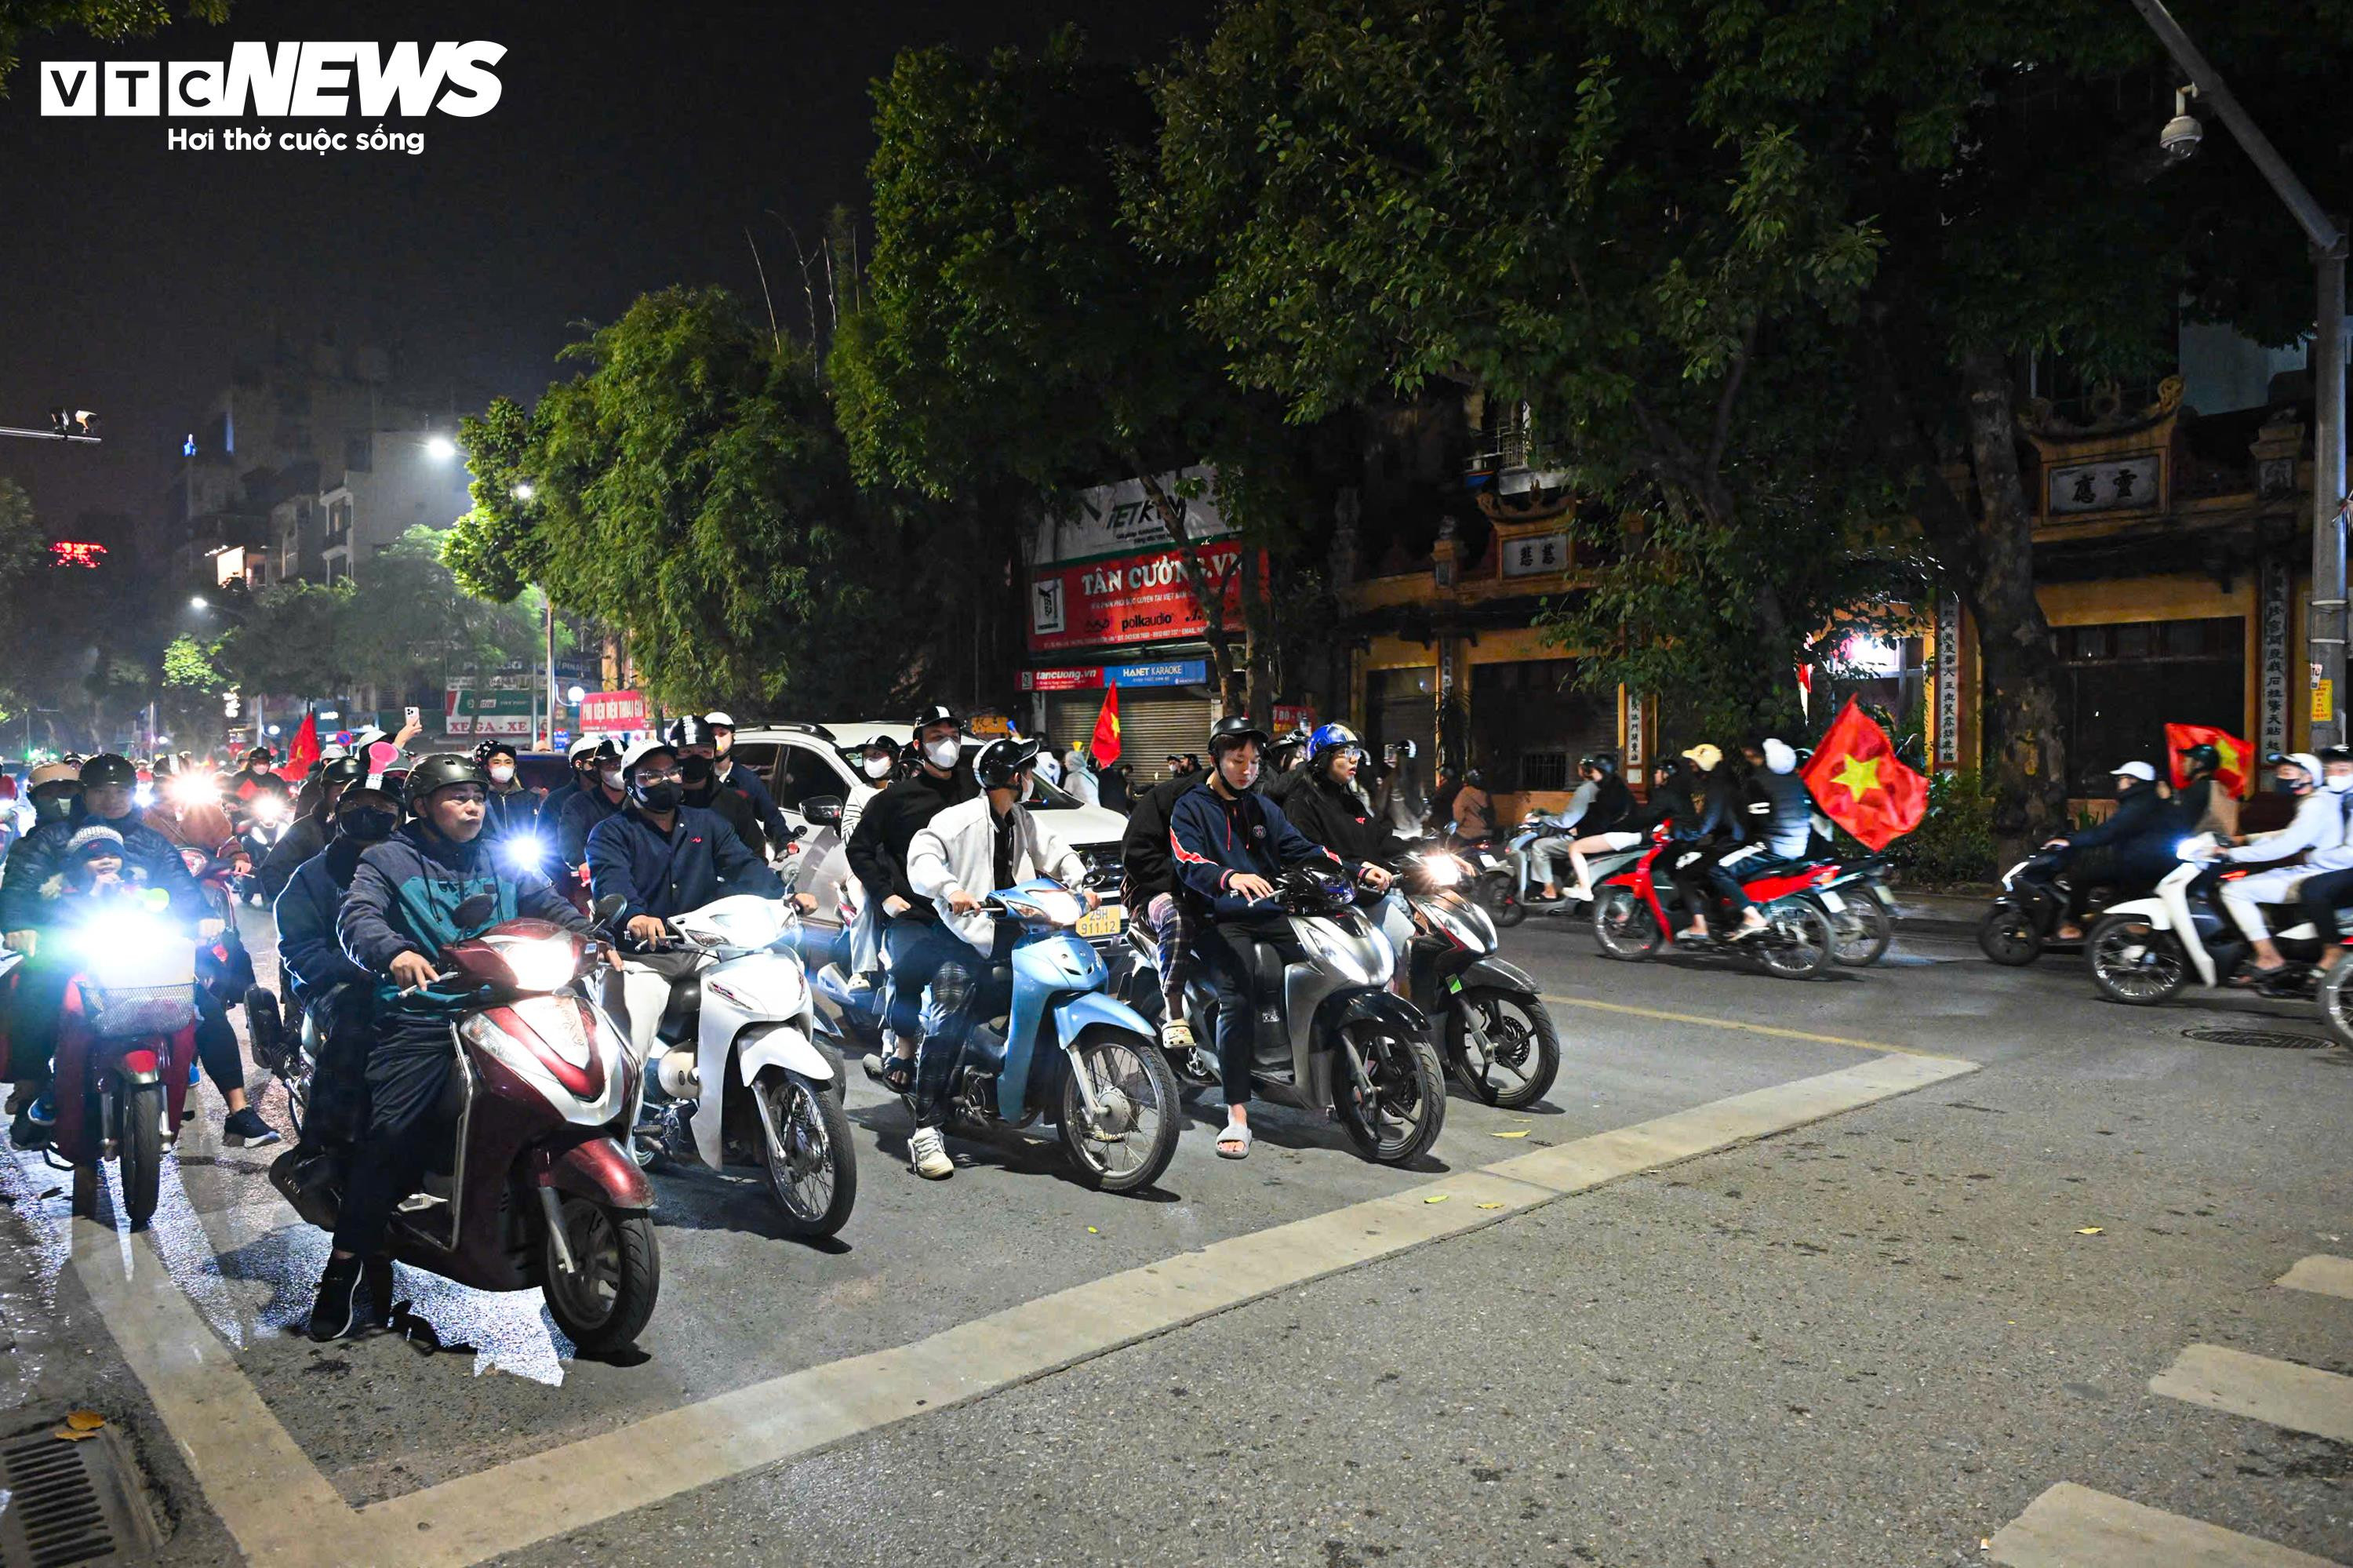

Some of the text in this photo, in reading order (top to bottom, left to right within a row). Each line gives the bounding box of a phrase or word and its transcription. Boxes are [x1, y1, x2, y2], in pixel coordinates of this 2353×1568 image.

[1082, 567, 1122, 595] TÂN
[1122, 613, 1172, 631] polkaudio
[1036, 669, 1097, 681] tancuong.vn
[1151, 665, 1182, 676] KARAOKE
[450, 722, 470, 733] XE
[475, 721, 495, 733] GA
[507, 721, 527, 732] XE
[1089, 909, 1108, 921] 29H
[1082, 921, 1115, 934] 911.12
